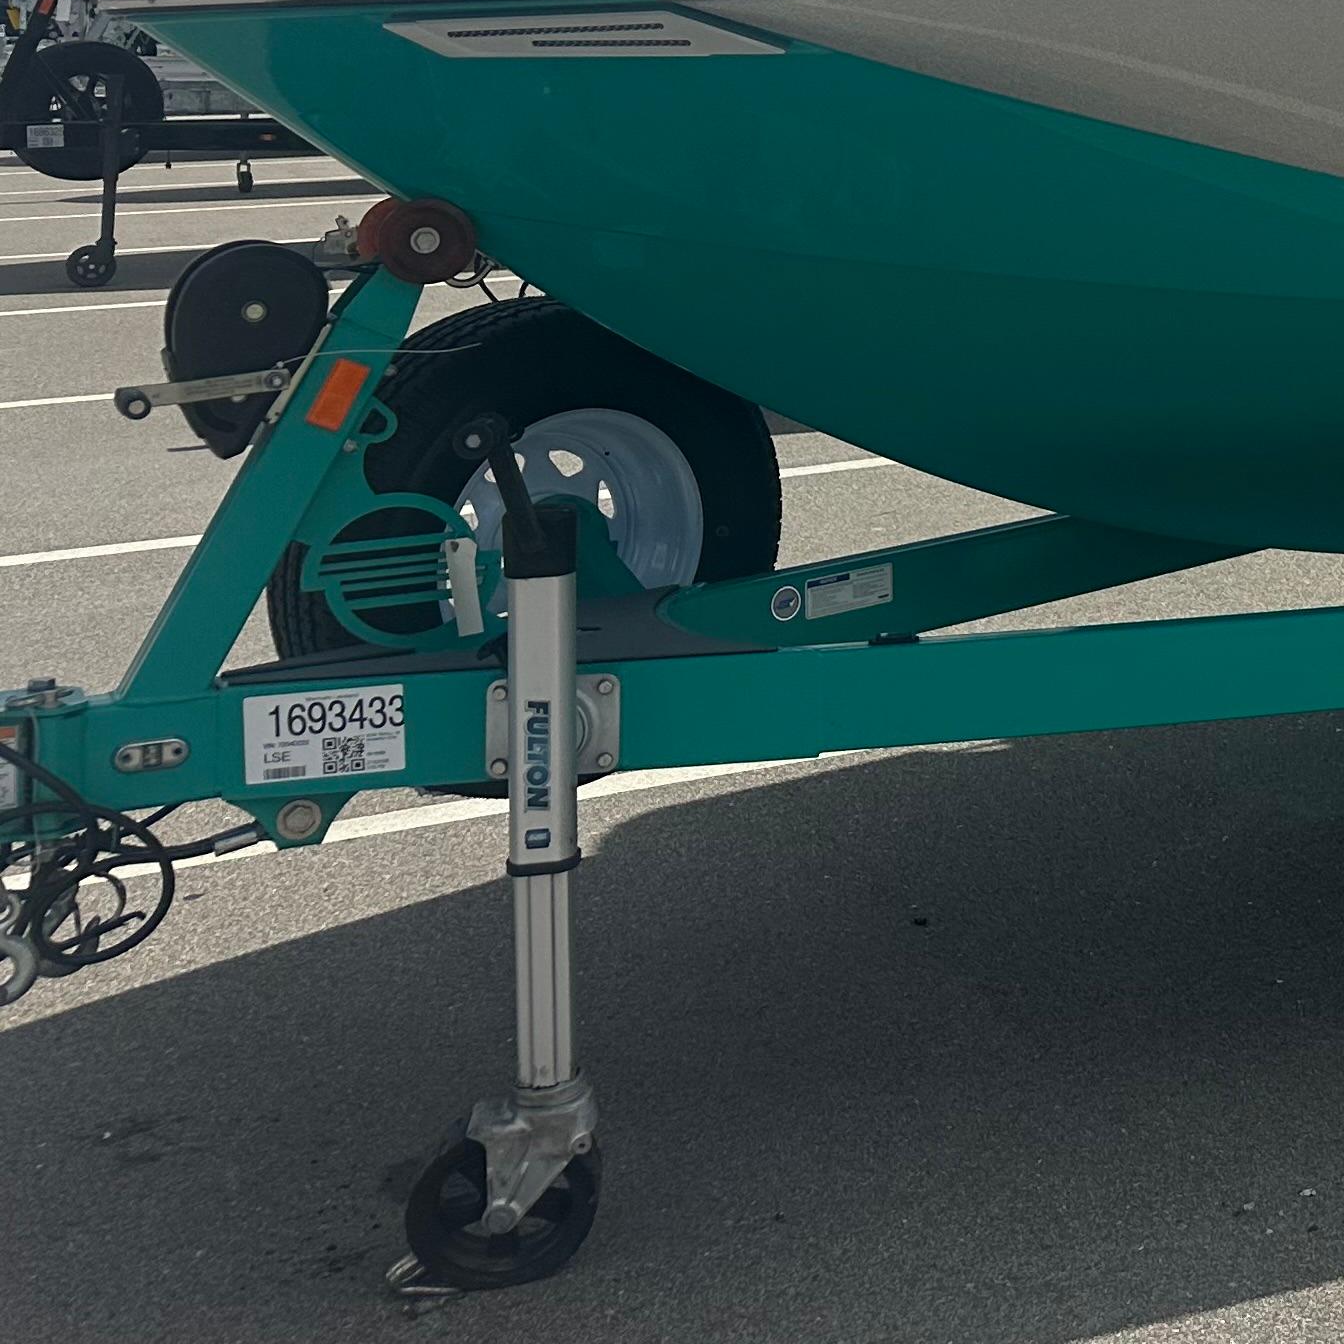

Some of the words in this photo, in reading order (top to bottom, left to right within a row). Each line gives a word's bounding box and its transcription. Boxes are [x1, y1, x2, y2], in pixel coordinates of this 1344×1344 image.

[268, 694, 405, 737] 1693433
[263, 751, 291, 763] LSE
[526, 700, 550, 810] FULTON
